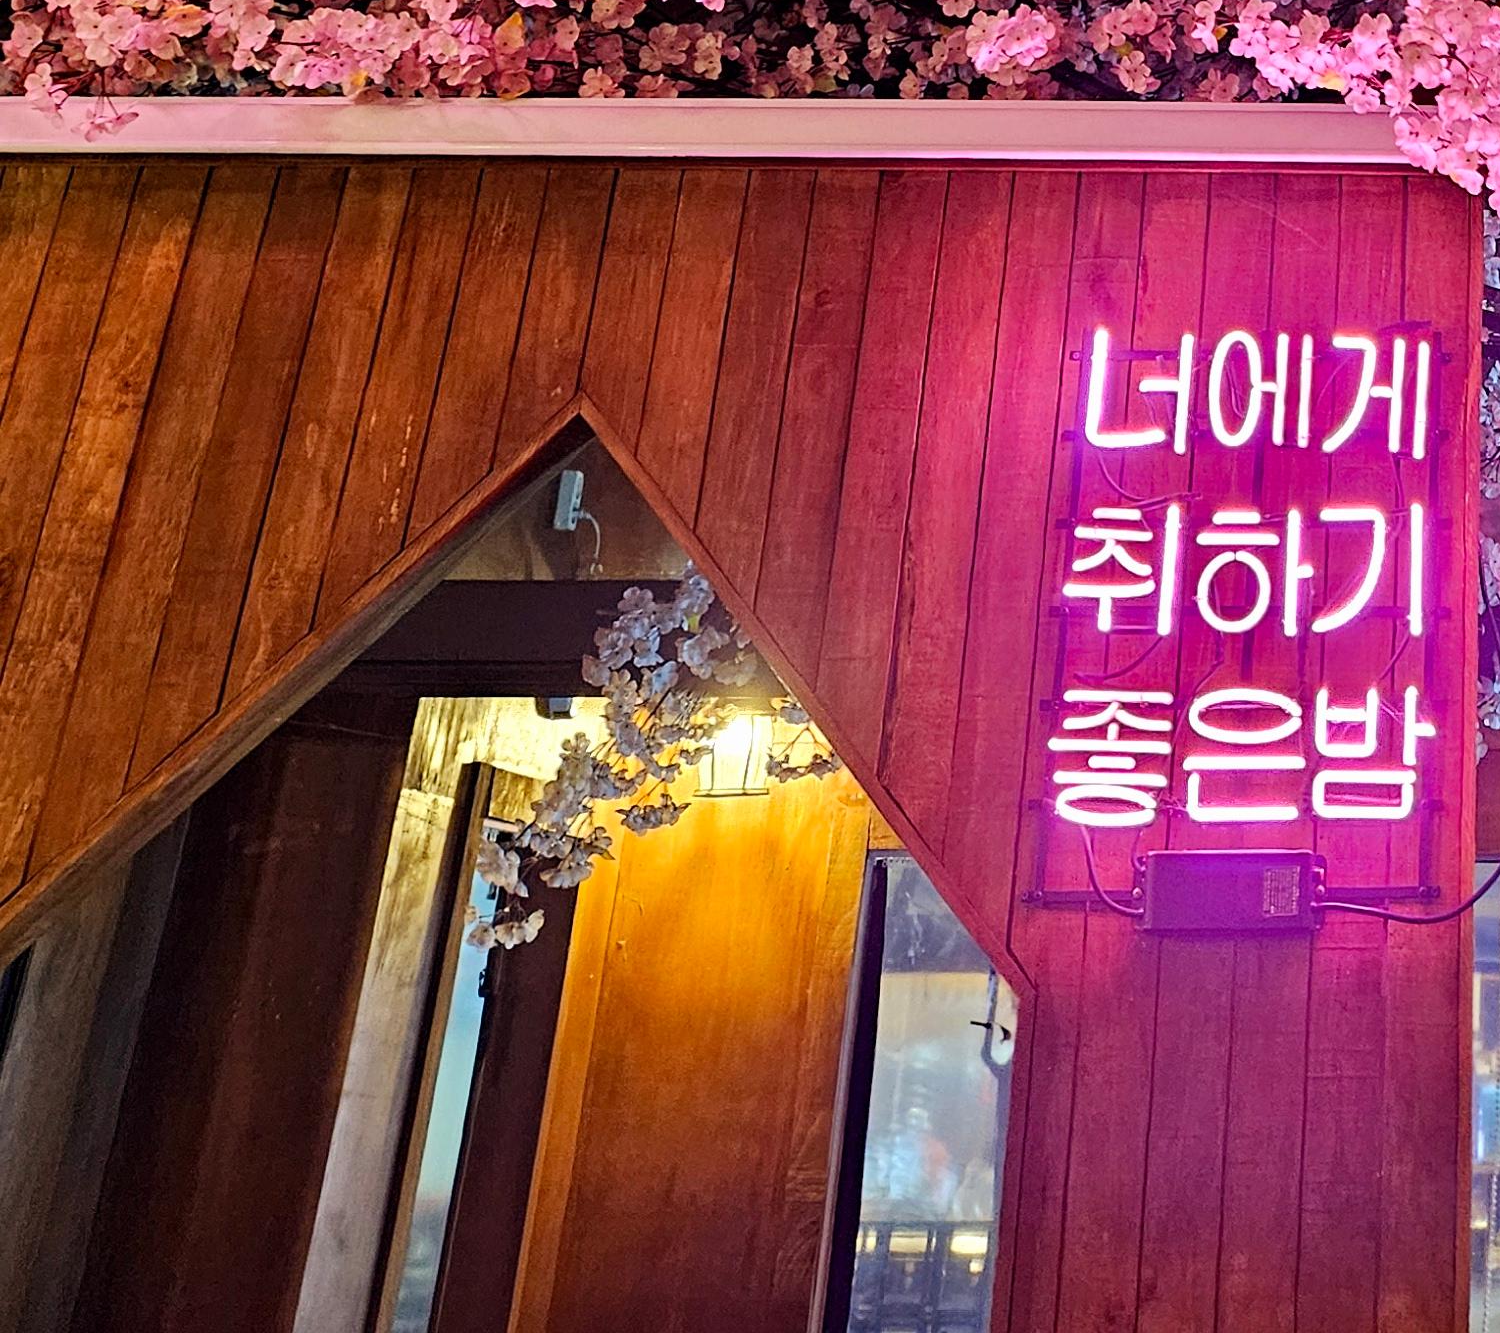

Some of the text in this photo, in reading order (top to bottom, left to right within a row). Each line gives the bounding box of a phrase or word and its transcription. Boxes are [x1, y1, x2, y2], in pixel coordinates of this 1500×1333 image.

[1084, 328, 1430, 460] 너에게
[1061, 503, 1424, 637] 취하기
[1046, 685, 1437, 827] 좋은밤
